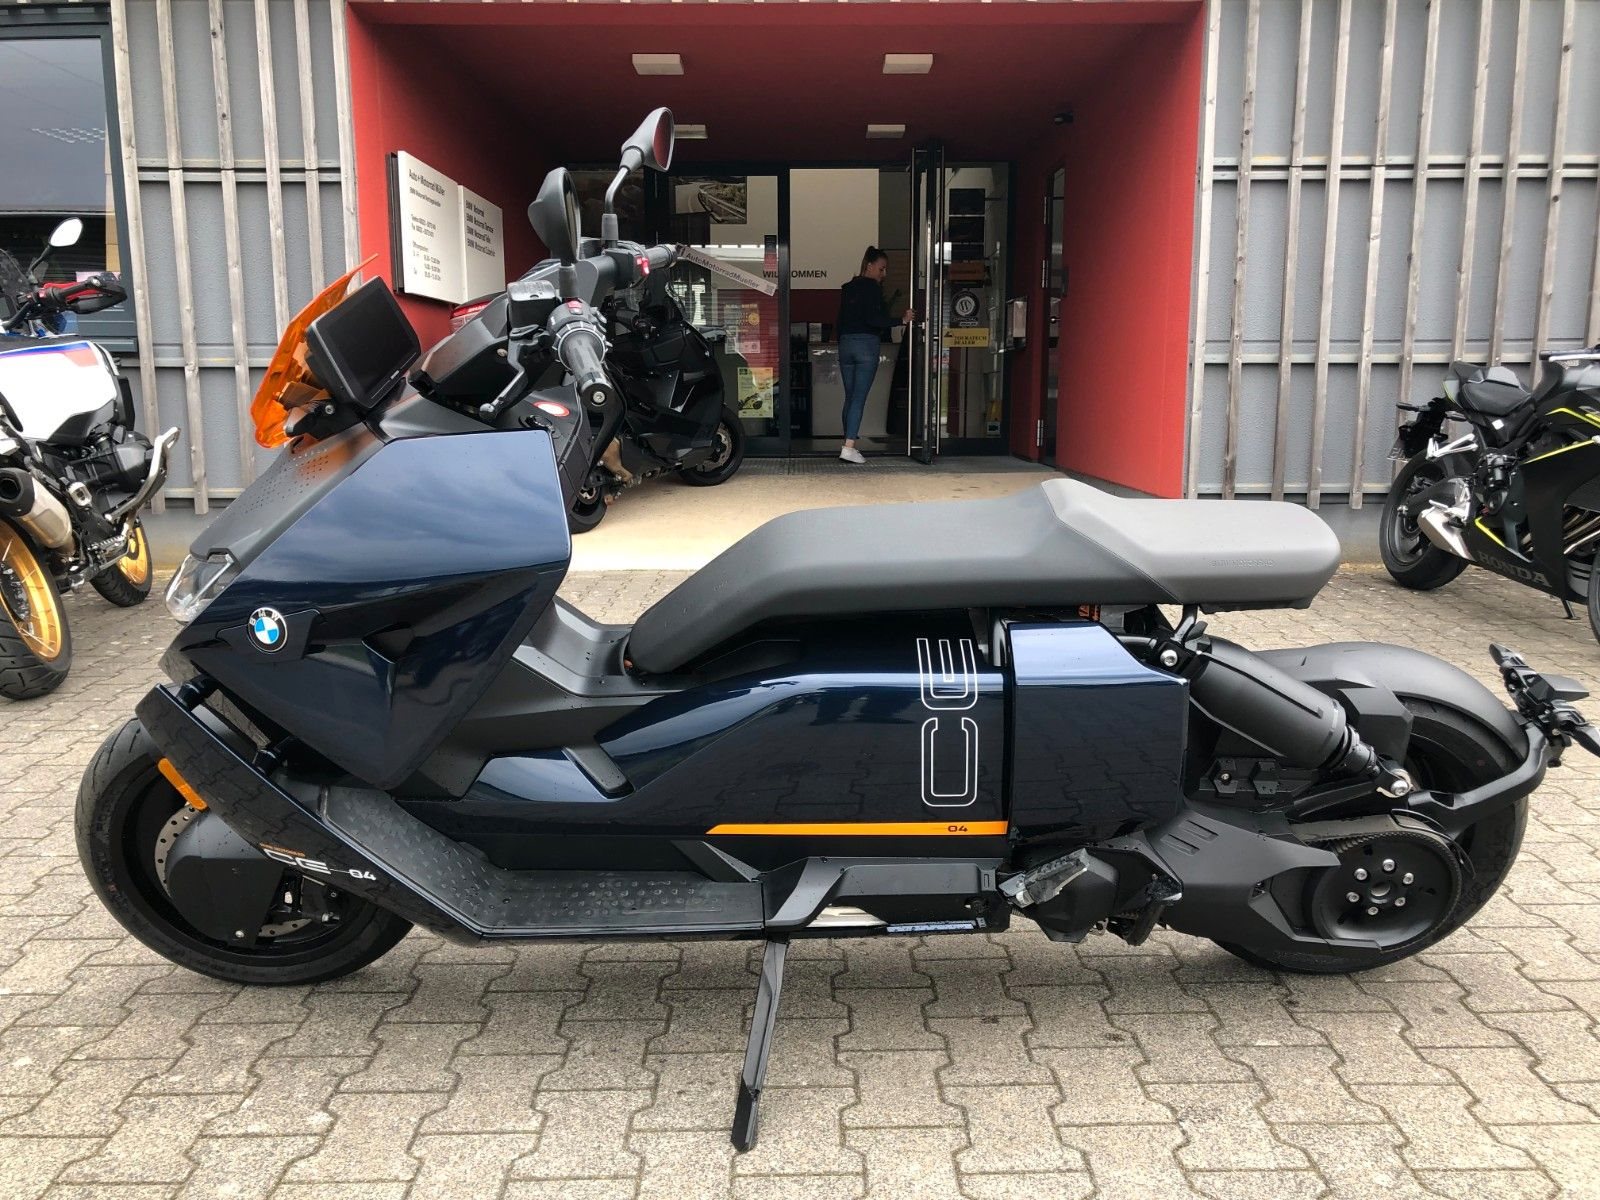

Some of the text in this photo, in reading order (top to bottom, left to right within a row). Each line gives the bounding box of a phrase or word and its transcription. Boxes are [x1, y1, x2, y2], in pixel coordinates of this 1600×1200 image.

[685, 252, 760, 289] AutoMotorradMueller
[763, 270, 828, 278] WILOMMEN
[1479, 551, 1552, 588] HONDA
[249, 609, 281, 626] BMW
[263, 848, 377, 881] CE 04
